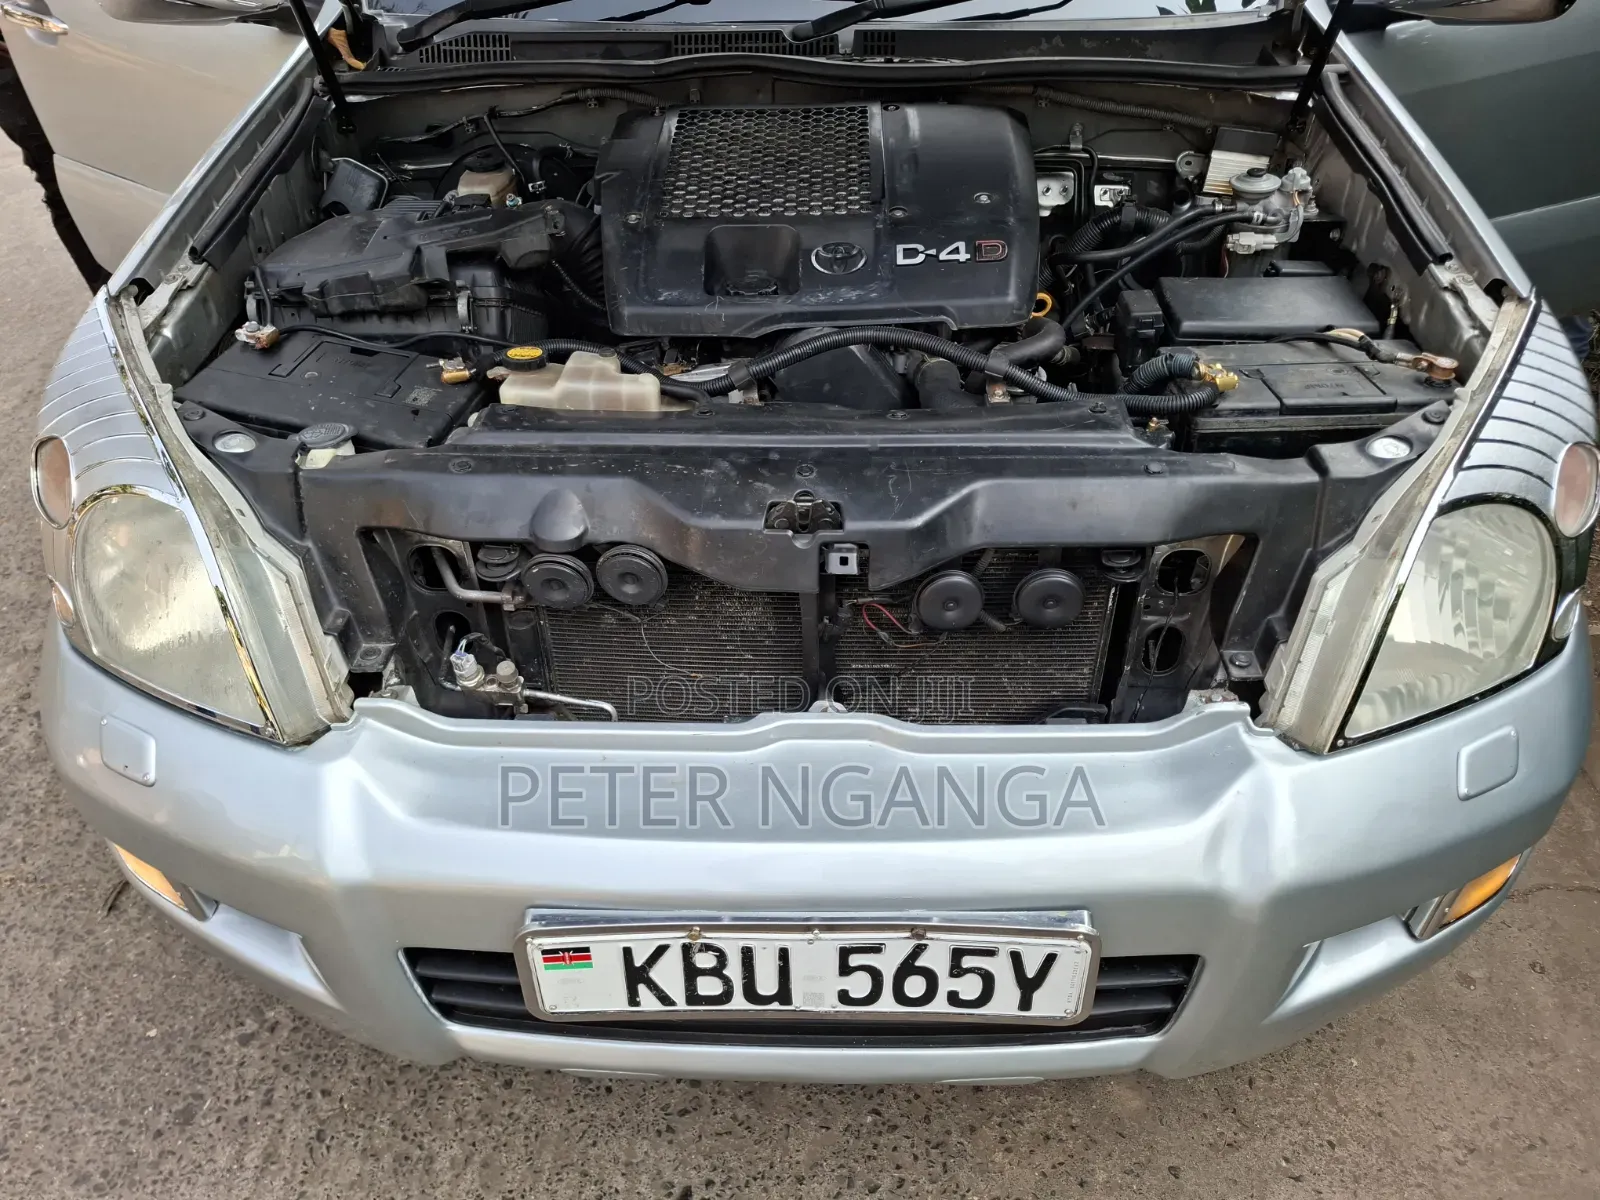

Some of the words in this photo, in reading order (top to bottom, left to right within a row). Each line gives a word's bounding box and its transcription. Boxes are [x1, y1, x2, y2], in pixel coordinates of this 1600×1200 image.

[895, 240, 1009, 265] D-4D
[621, 943, 794, 1007] KBU
[836, 943, 1060, 1012] 565Y
